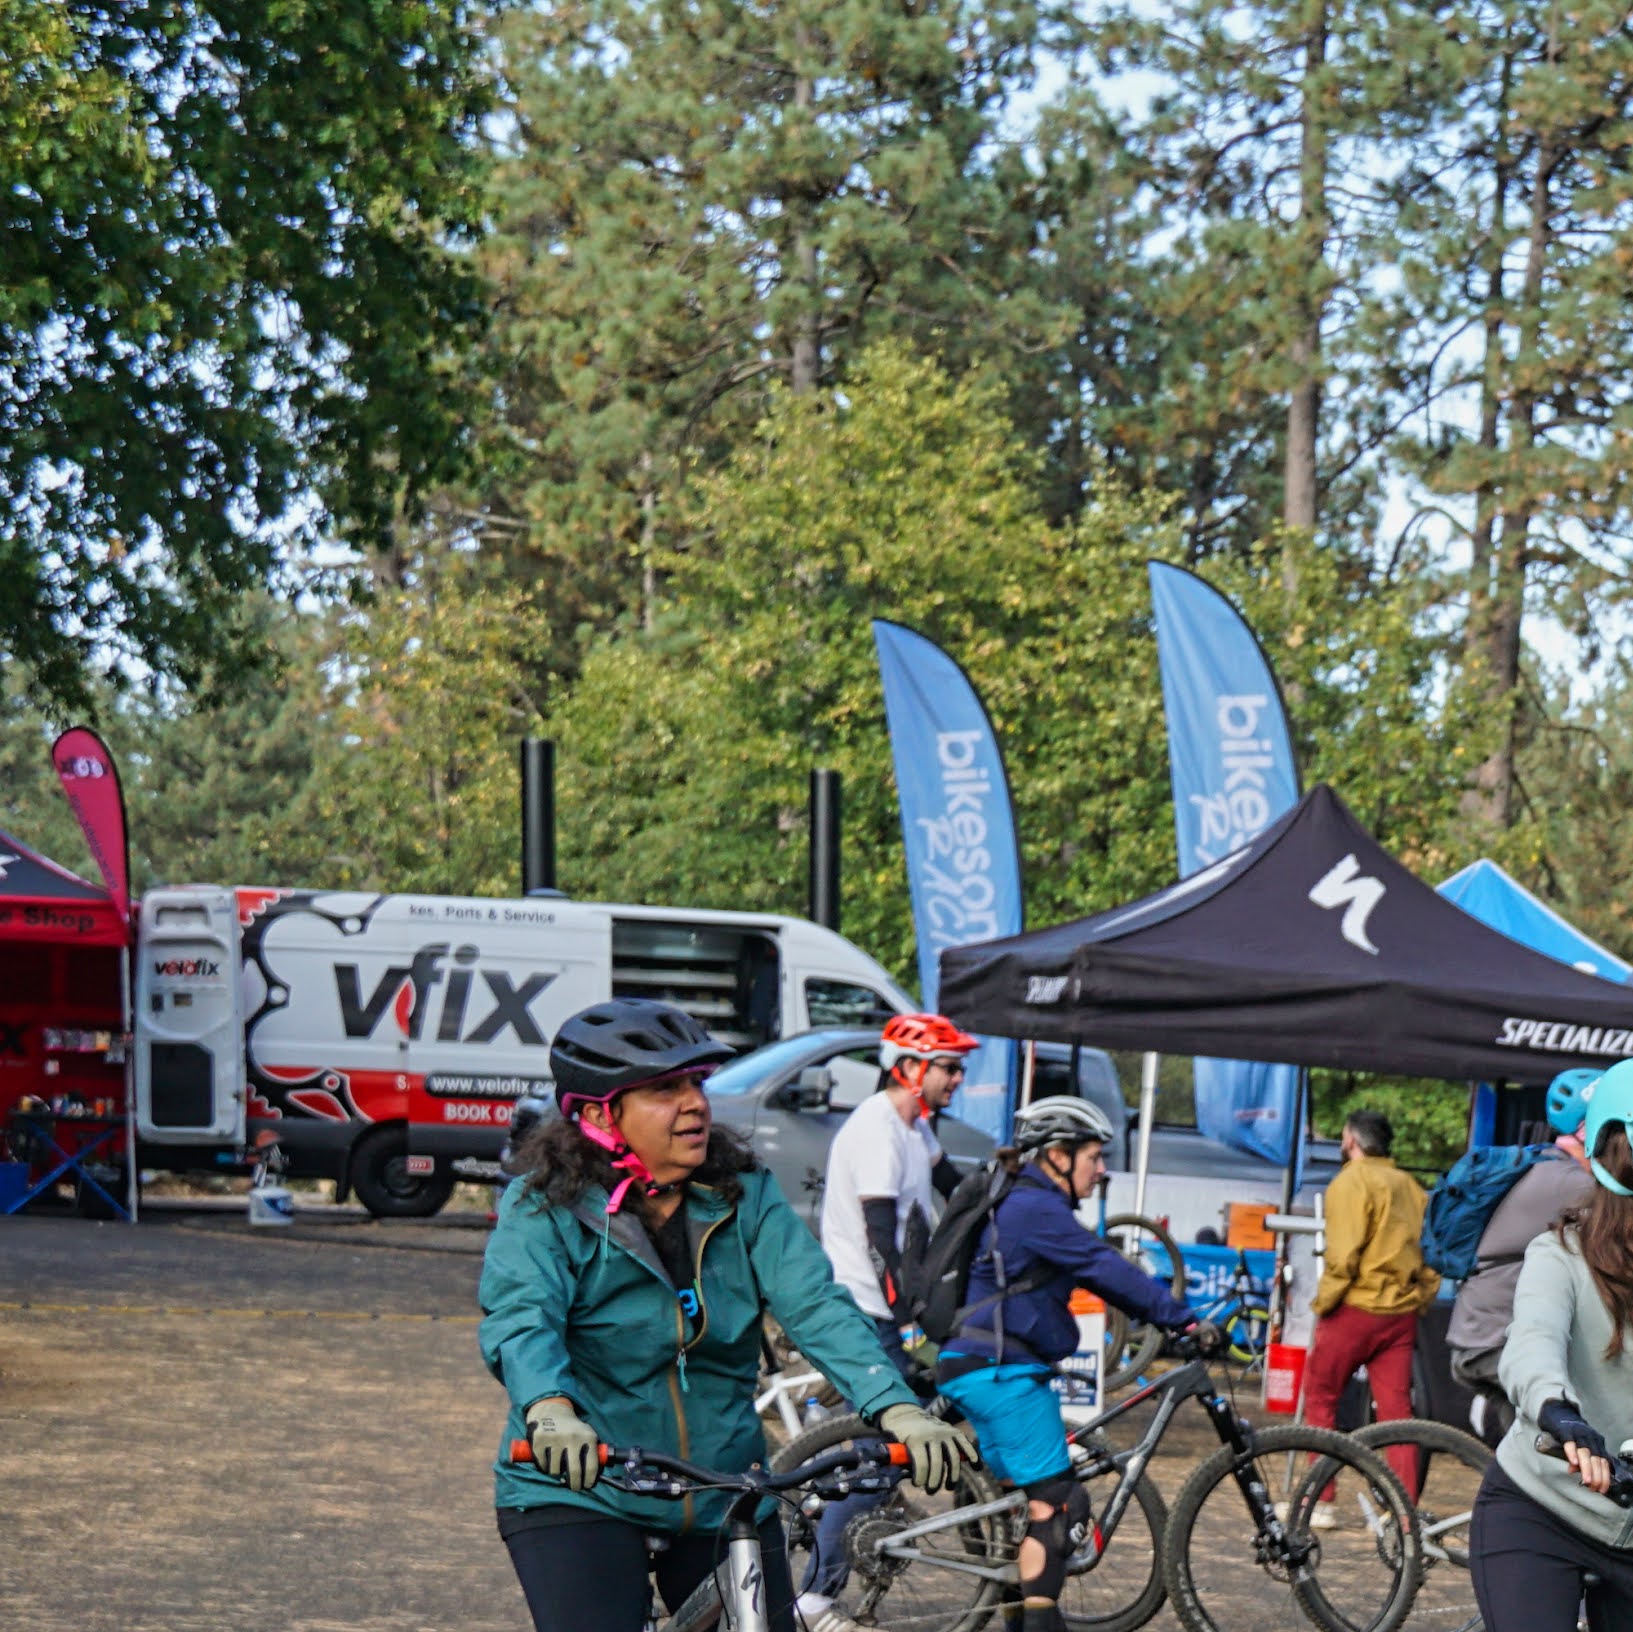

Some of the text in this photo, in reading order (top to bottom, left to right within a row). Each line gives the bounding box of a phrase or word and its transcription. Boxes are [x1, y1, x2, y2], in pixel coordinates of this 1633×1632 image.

[23, 906, 95, 932] Shop
[446, 906, 482, 920] Parts
[488, 908, 497, 920] &
[504, 908, 556, 924] Service
[155, 958, 219, 978] velofix
[334, 943, 559, 1046] vfix
[444, 1102, 491, 1121] BOOK
